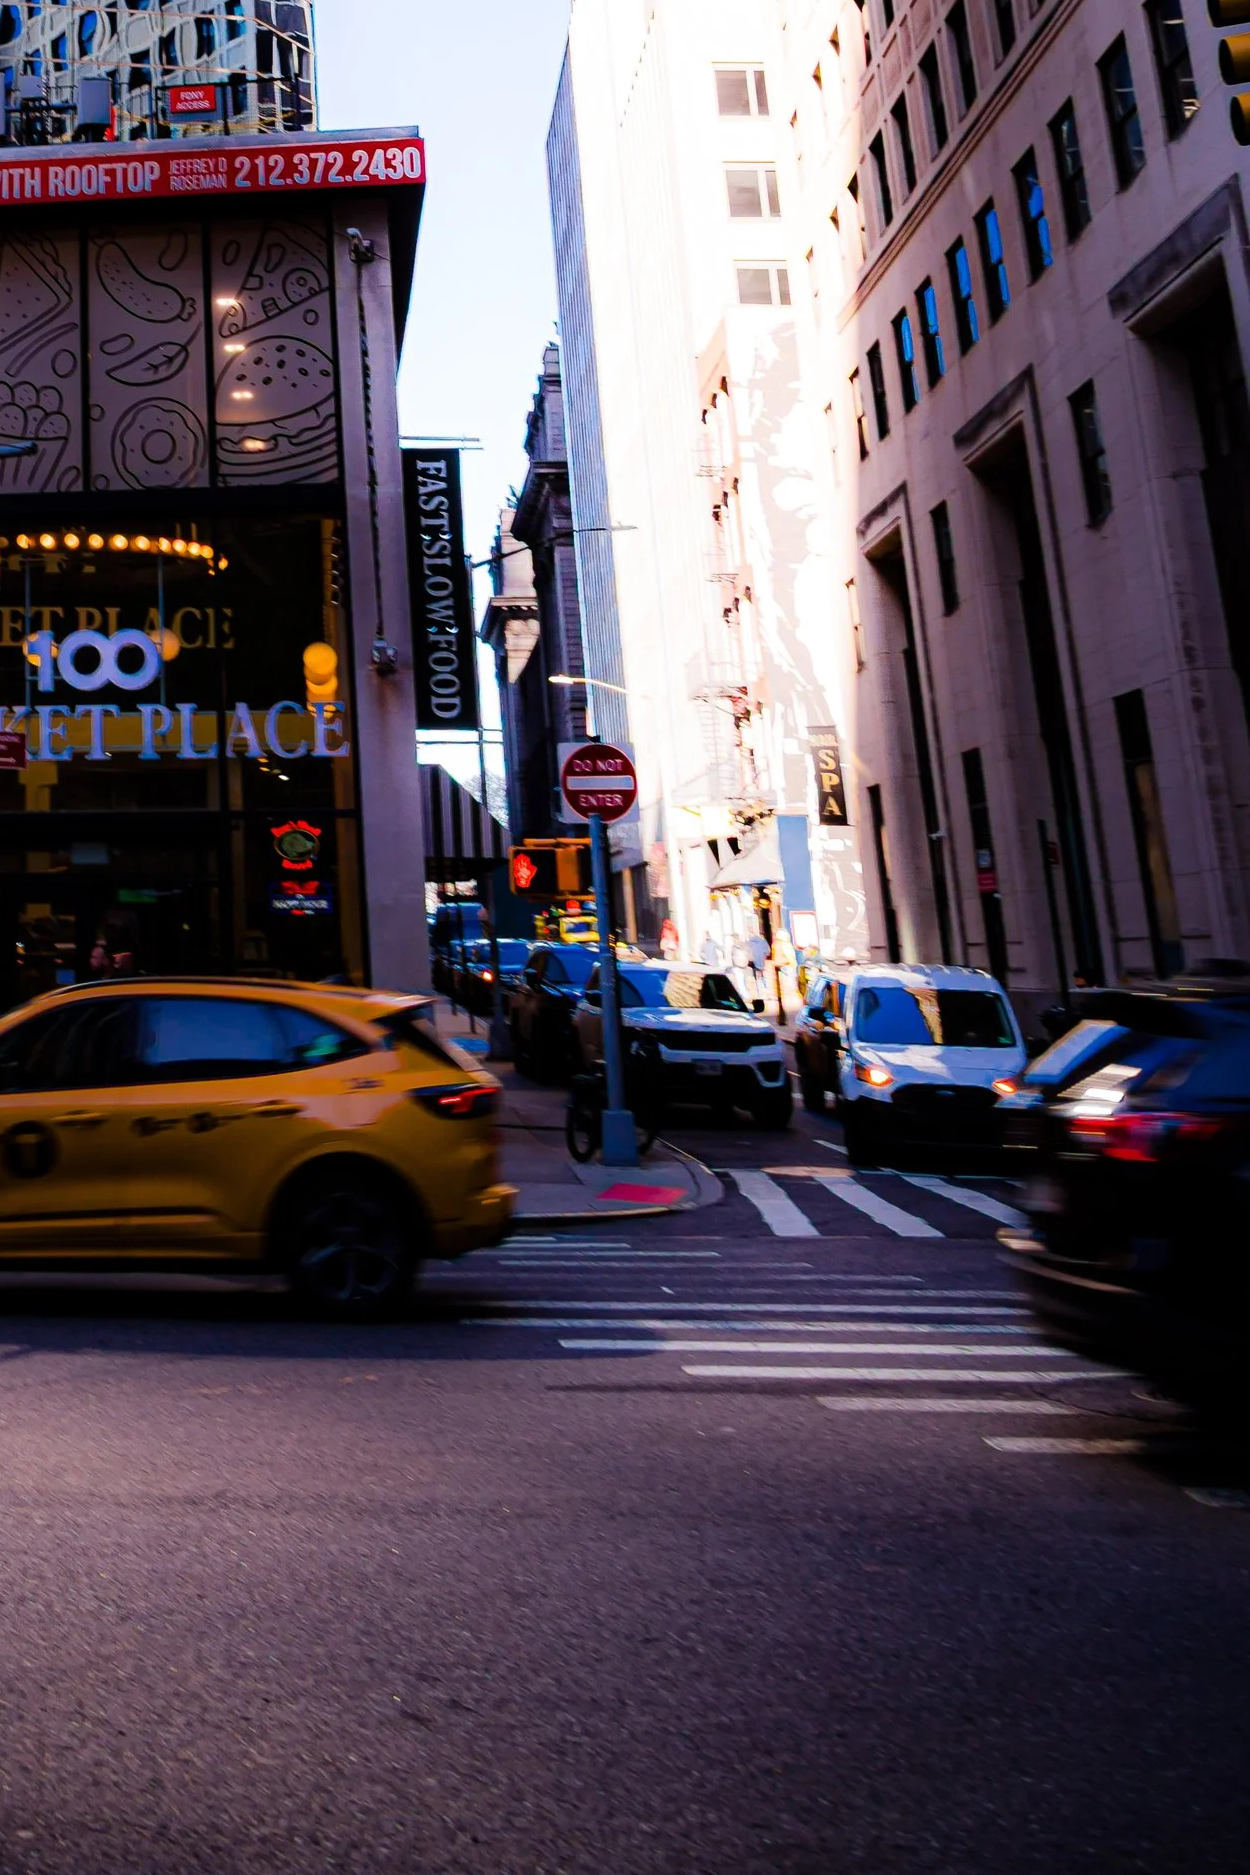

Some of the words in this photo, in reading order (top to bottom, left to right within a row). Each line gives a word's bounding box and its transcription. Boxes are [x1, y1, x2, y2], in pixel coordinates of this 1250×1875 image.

[176, 100, 210, 110] ACCESS
[49, 160, 160, 197] ROOFTOP
[168, 158, 216, 175] JEFFREY
[170, 174, 227, 191] ROSEMAN
[234, 146, 422, 188] 212.372.2430
[416, 459, 448, 535] FAST
[421, 536, 455, 632] SLOW
[26, 628, 164, 692] 100
[427, 633, 462, 719] FOOD
[136, 700, 350, 759] PLACE
[573, 759, 593, 772] DO
[596, 759, 624, 772] NOT
[817, 749, 844, 816] SPA
[578, 794, 624, 807] ENTER
